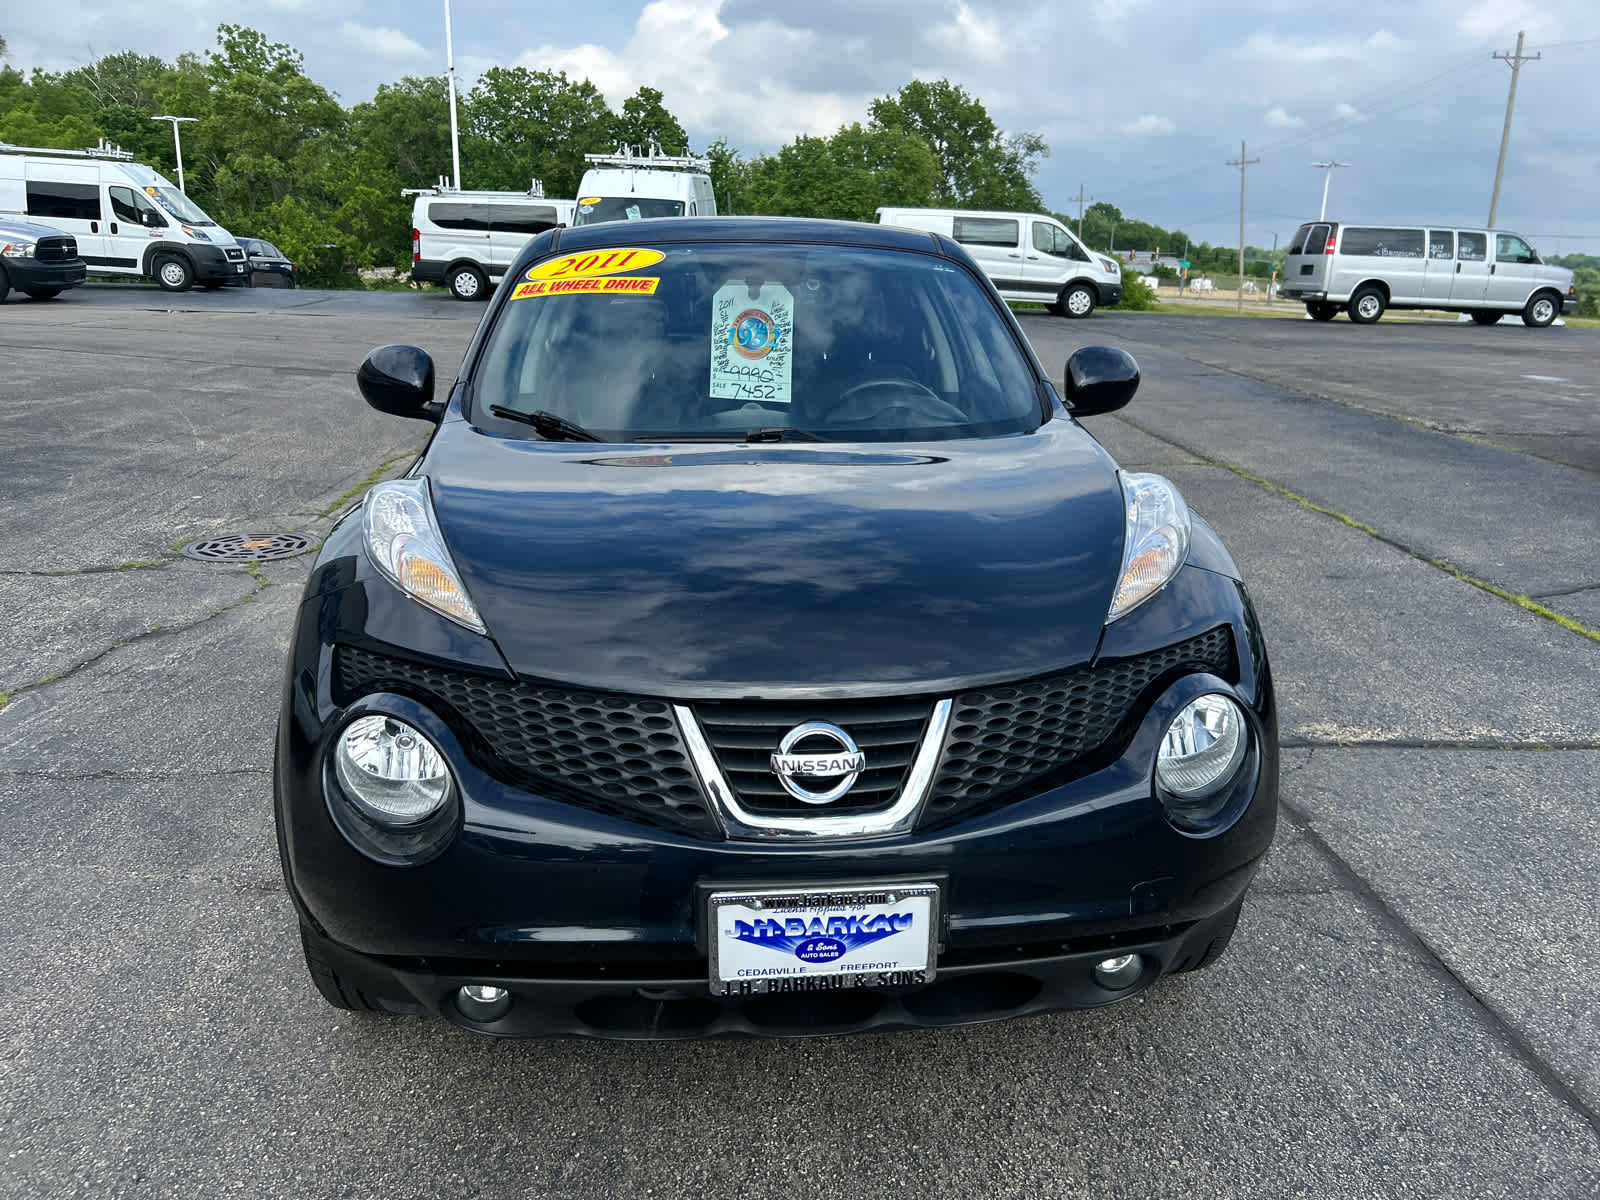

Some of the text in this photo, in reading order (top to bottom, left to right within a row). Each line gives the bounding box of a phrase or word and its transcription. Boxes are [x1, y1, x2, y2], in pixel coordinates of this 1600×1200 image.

[551, 250, 638, 277] 2011
[516, 279, 652, 297] ALL WHEEL DRIVE
[731, 383, 776, 400] 7452
[781, 758, 856, 772] NISSAN
[763, 893, 887, 908] www.barkau.com
[815, 942, 839, 952] Sons
[737, 966, 806, 977] CEDARVILLE
[840, 961, 899, 971] FREEPORT
[768, 974, 844, 993] BARKAU
[854, 973, 866, 987] &
[877, 969, 927, 986] SONS
